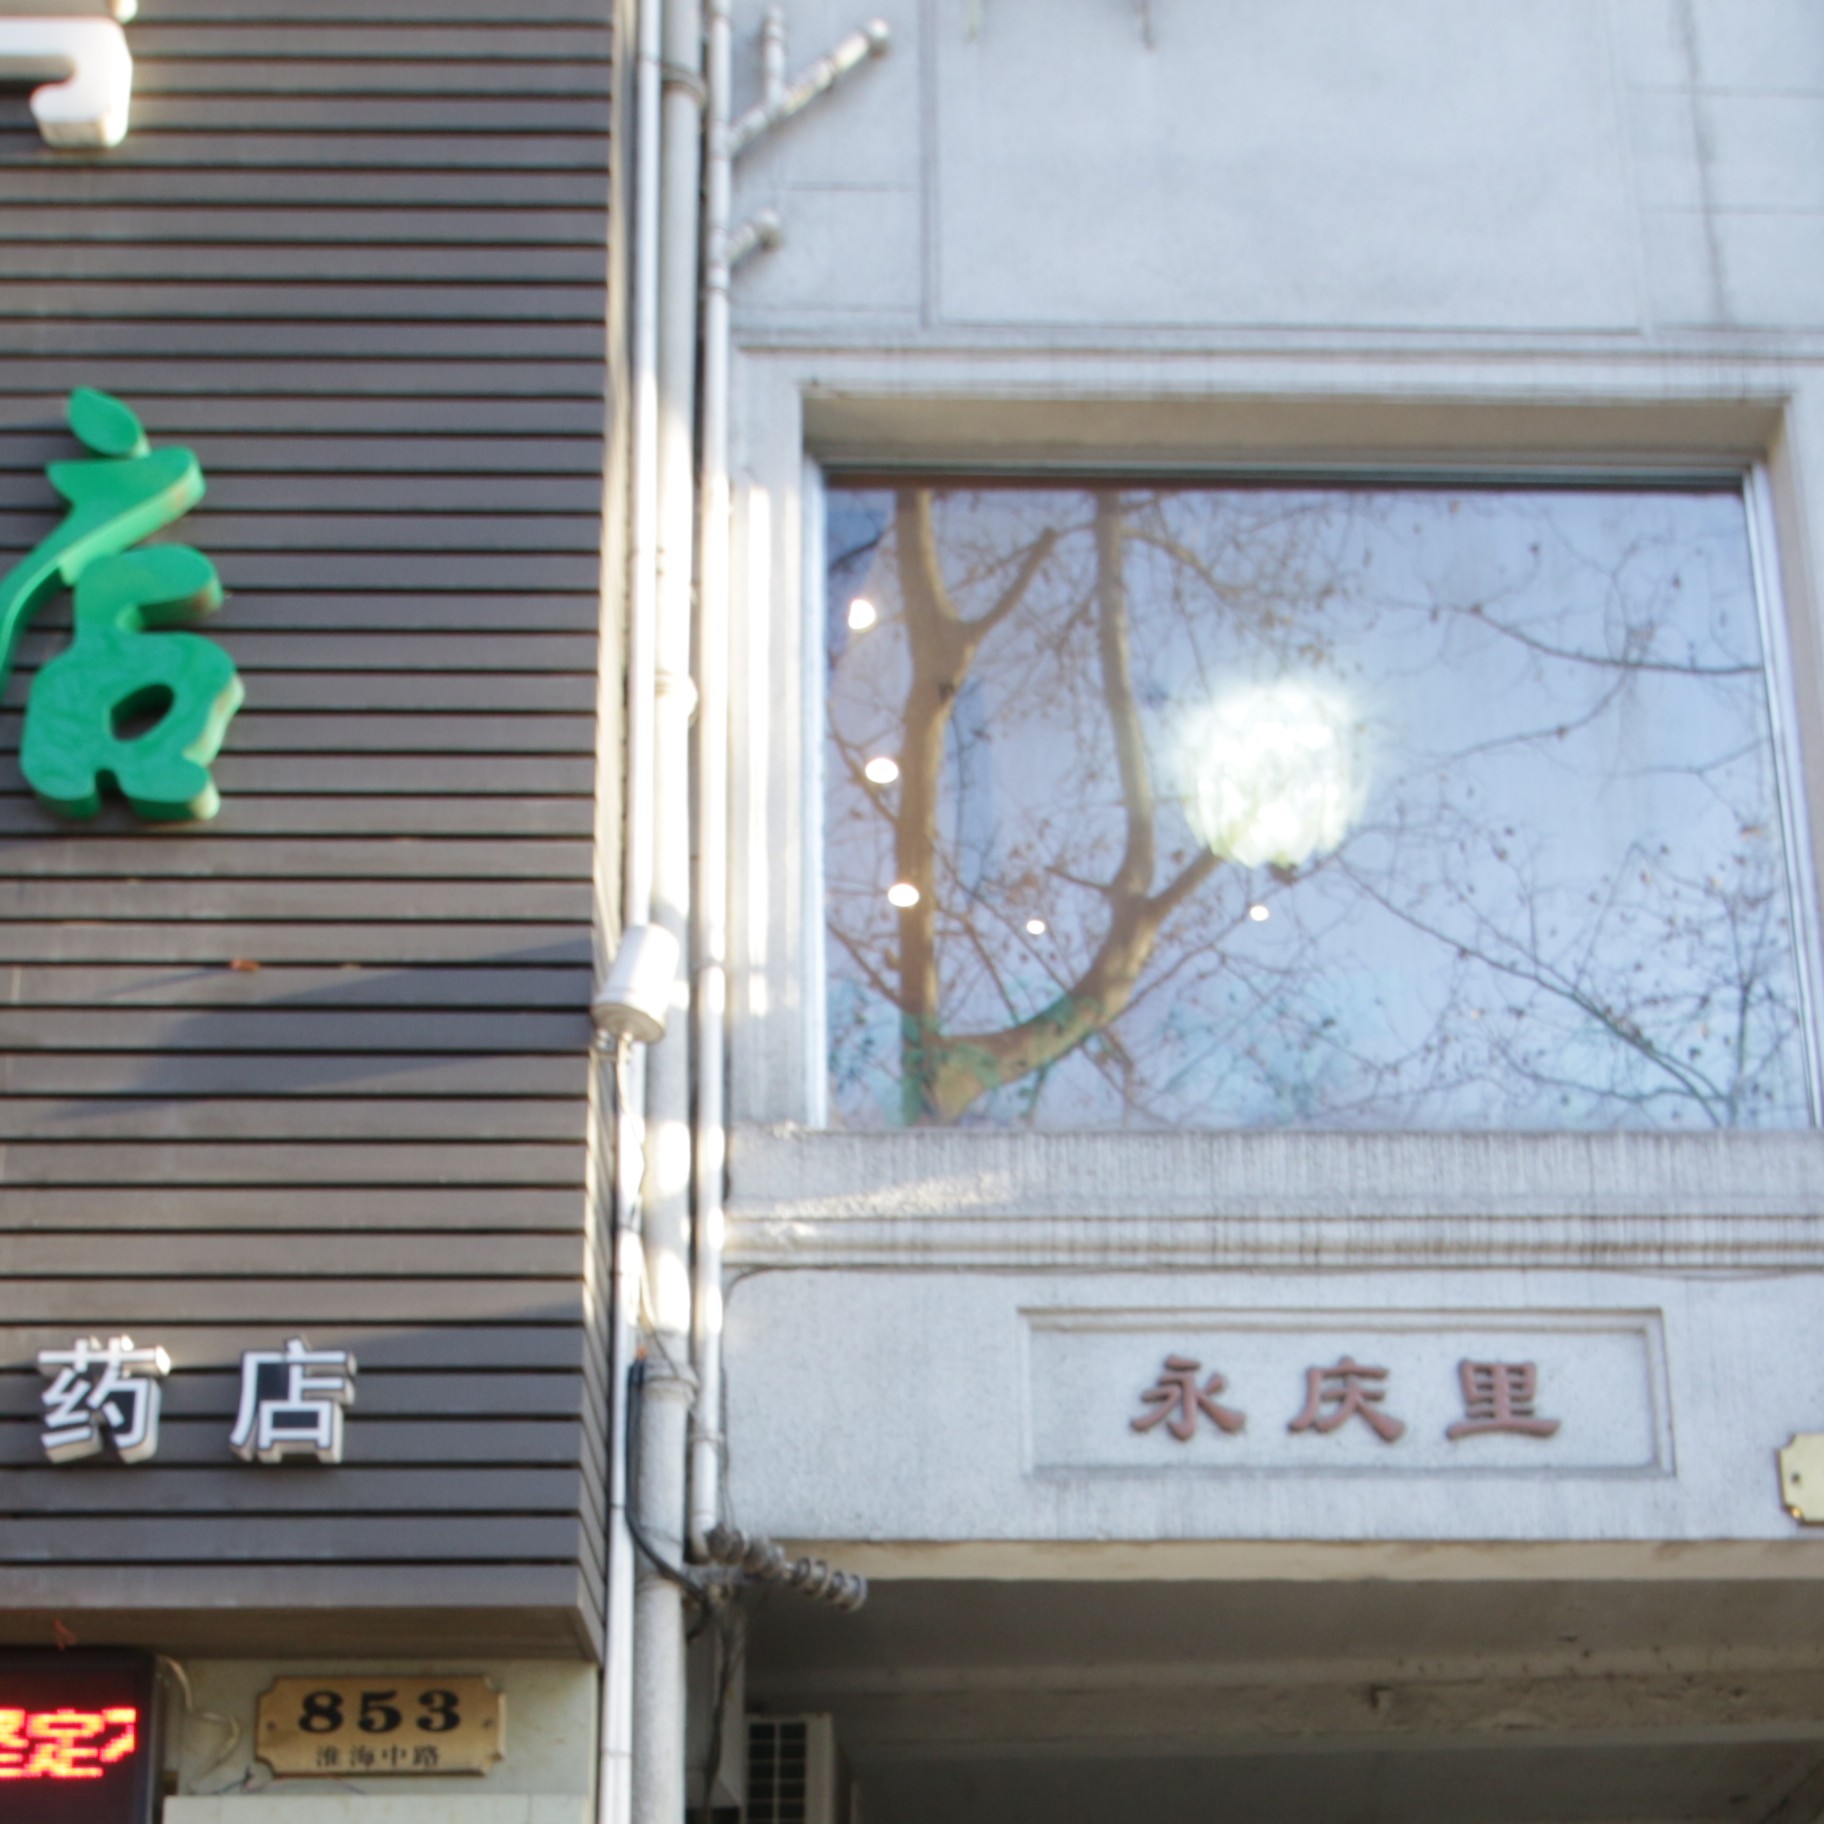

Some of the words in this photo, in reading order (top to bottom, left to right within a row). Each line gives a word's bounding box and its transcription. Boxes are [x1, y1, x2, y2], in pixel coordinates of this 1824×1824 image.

[1130, 1355, 1559, 1444] 永庆里
[299, 1688, 464, 1735] 853
[315, 1742, 442, 1773] 淮海中路
